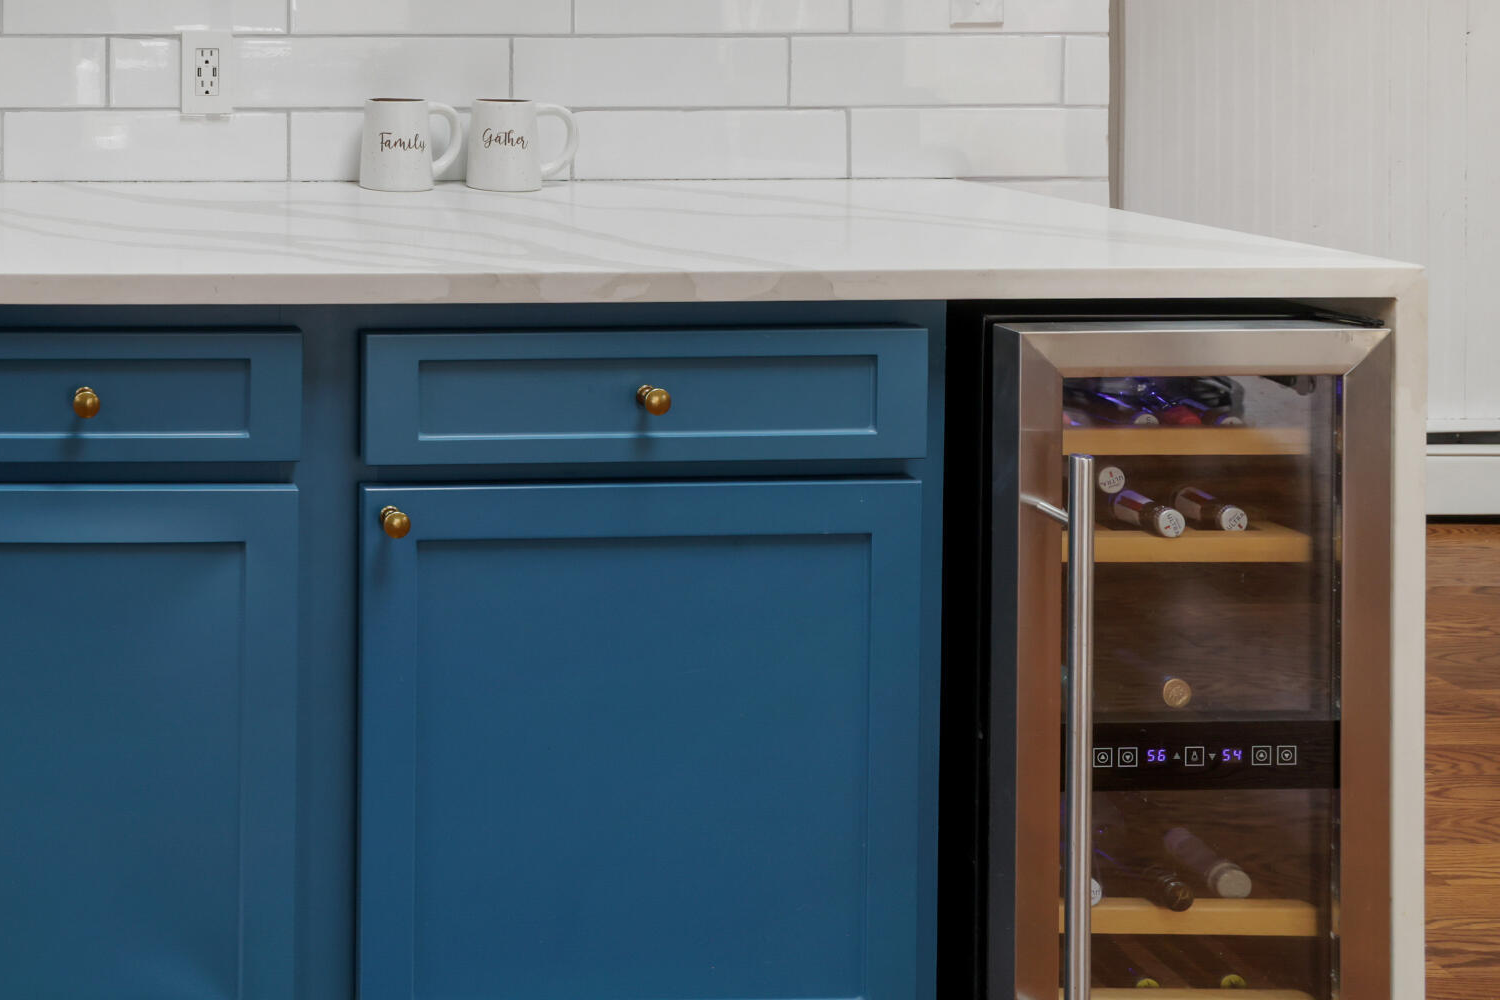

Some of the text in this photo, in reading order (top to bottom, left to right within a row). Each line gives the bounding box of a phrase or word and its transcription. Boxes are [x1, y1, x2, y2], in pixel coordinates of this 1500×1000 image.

[379, 132, 427, 153] Family
[482, 127, 529, 150] Gather
[1166, 513, 1180, 537] ULTRA
[1226, 512, 1245, 530] ULTRA
[1147, 749, 1167, 762] 56
[1222, 748, 1243, 762] 54
